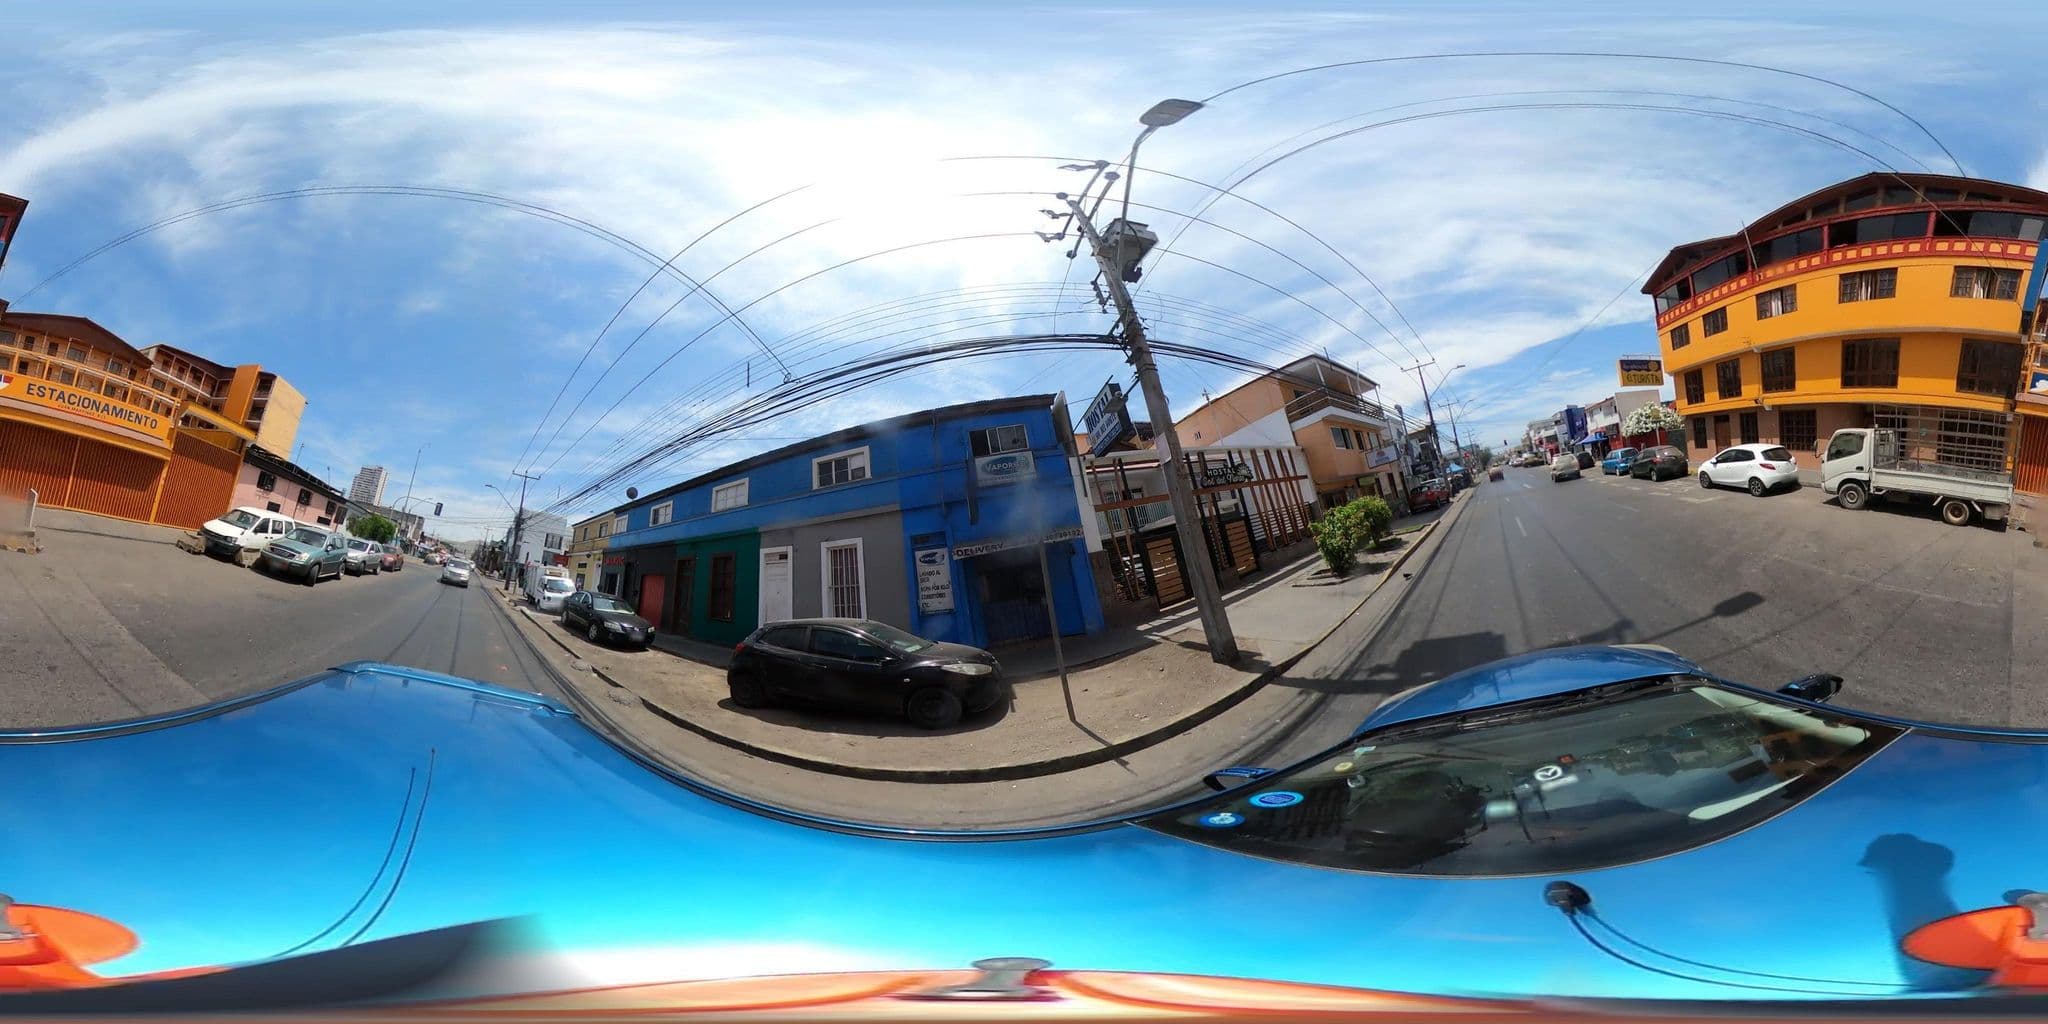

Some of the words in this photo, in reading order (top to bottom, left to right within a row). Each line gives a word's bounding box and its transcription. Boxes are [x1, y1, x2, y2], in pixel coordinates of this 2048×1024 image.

[26, 383, 158, 429] ESTACIONAMIENTO
[1207, 468, 1236, 476] HOSTAL
[955, 543, 1004, 557] DELIVERY
